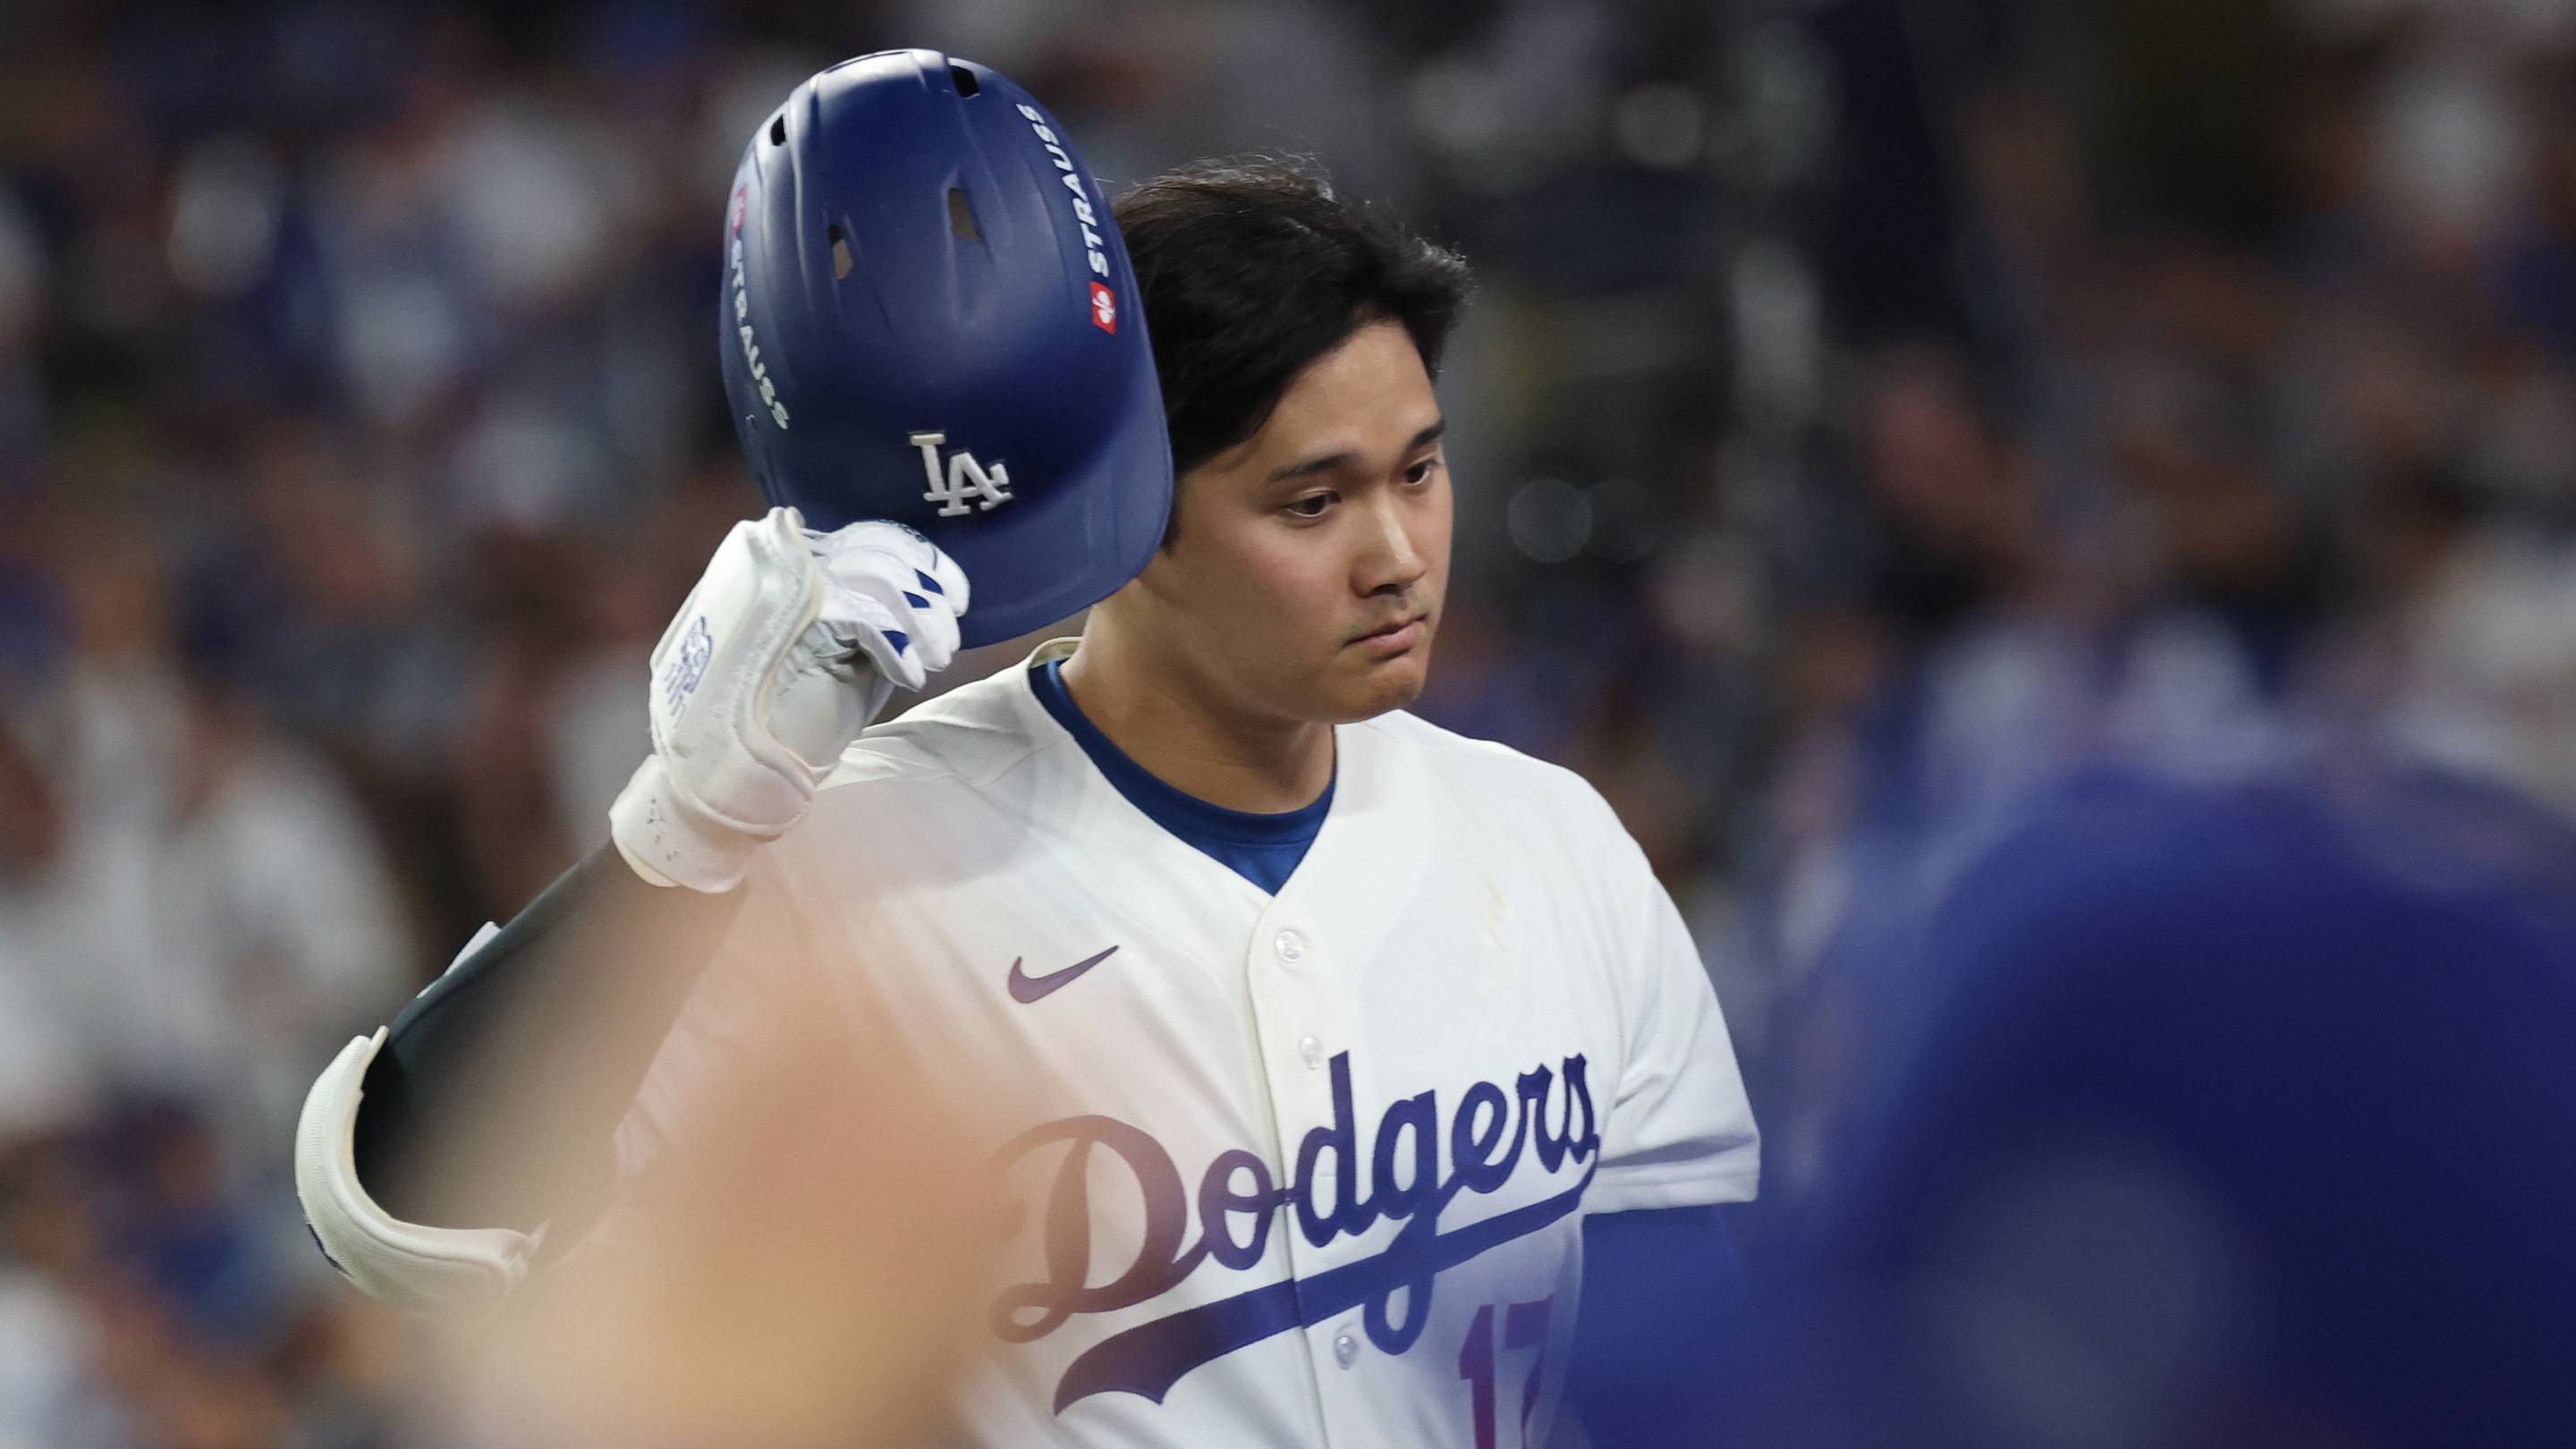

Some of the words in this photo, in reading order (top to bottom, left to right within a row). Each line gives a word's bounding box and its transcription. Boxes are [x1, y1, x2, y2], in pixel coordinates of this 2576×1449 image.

[1016, 103, 1109, 278] STRAUSS
[731, 238, 790, 430] STRAUSS
[909, 432, 1013, 517] LA
[988, 1049, 1600, 1356] Dodgers
[1458, 1293, 1555, 1449] 17
